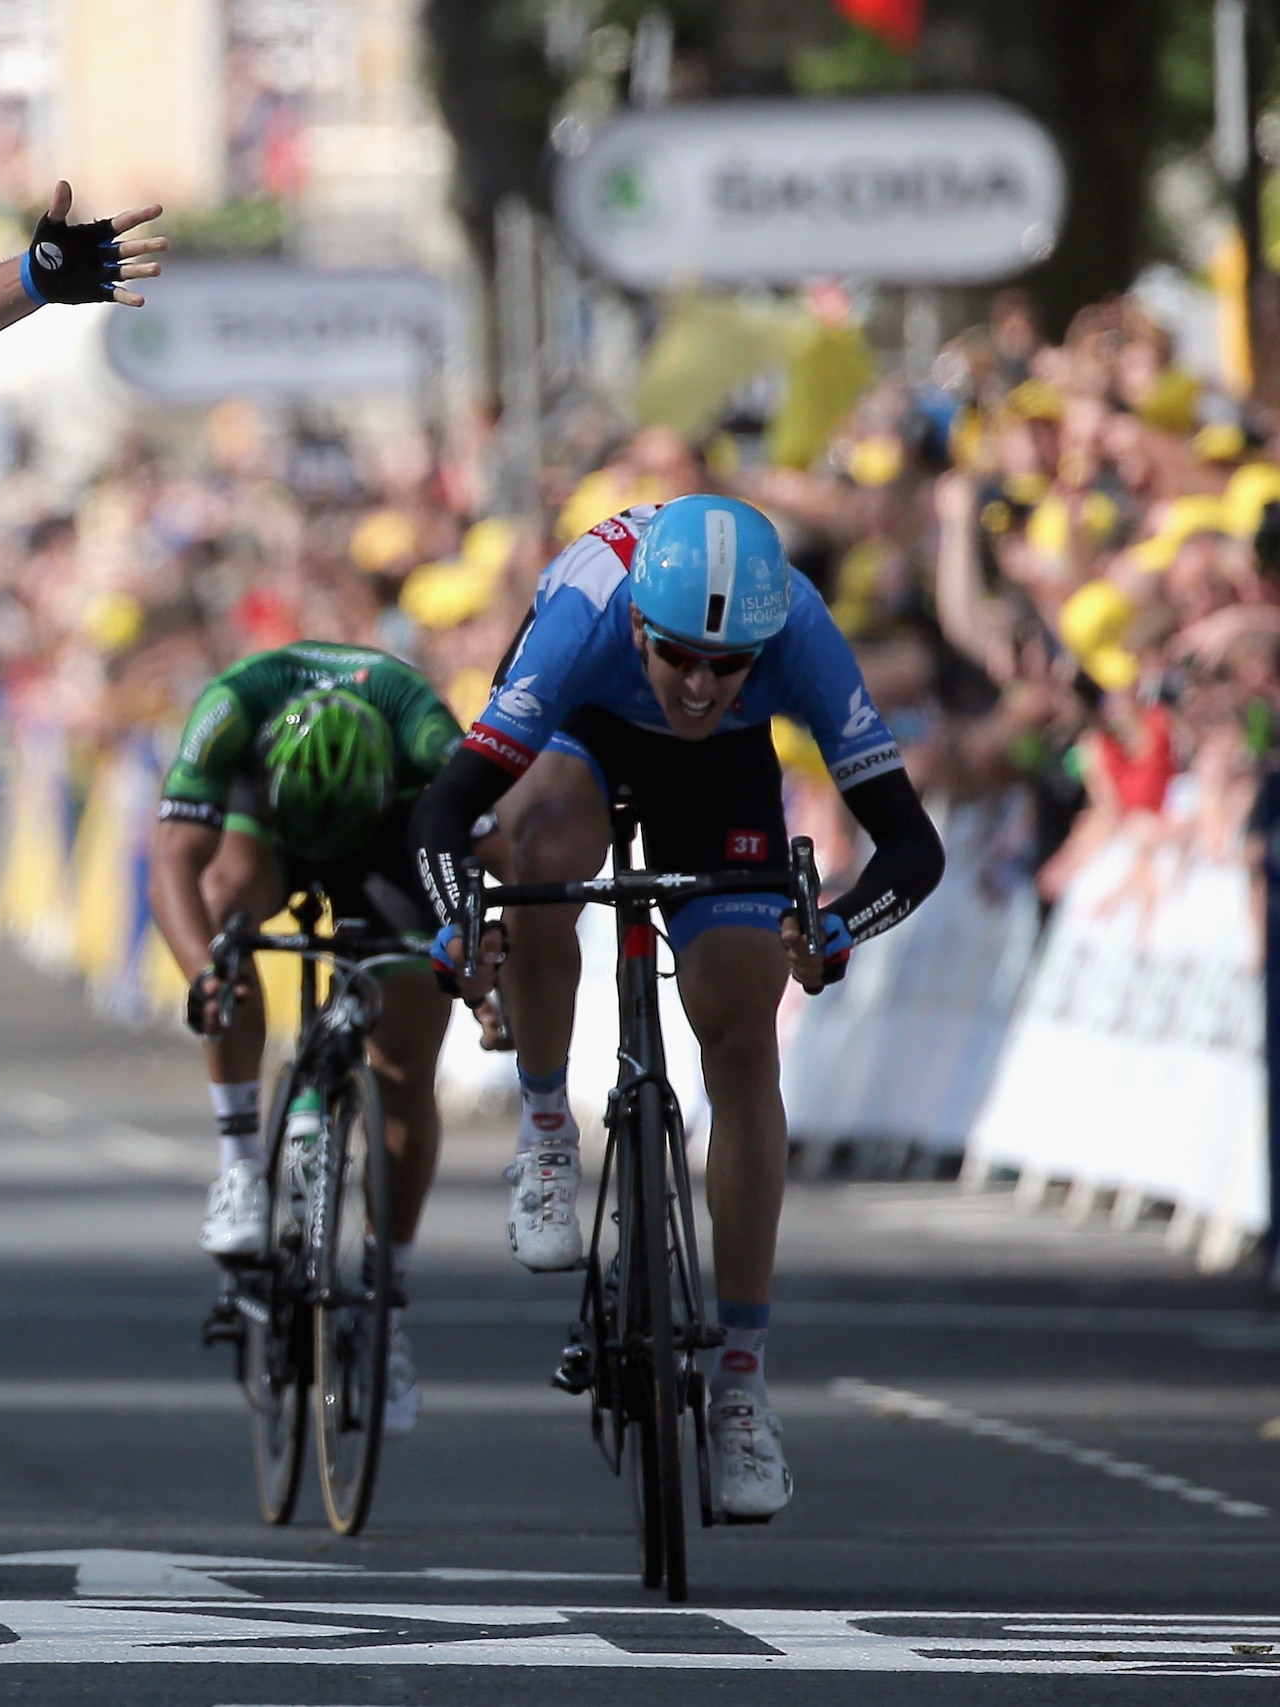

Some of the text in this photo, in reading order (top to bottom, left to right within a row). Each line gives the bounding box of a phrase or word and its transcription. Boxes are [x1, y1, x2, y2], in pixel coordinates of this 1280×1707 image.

[741, 590, 784, 611] ISLAND
[743, 604, 783, 625] HOUSE
[836, 748, 899, 780] GARMI
[733, 836, 761, 855] 3T
